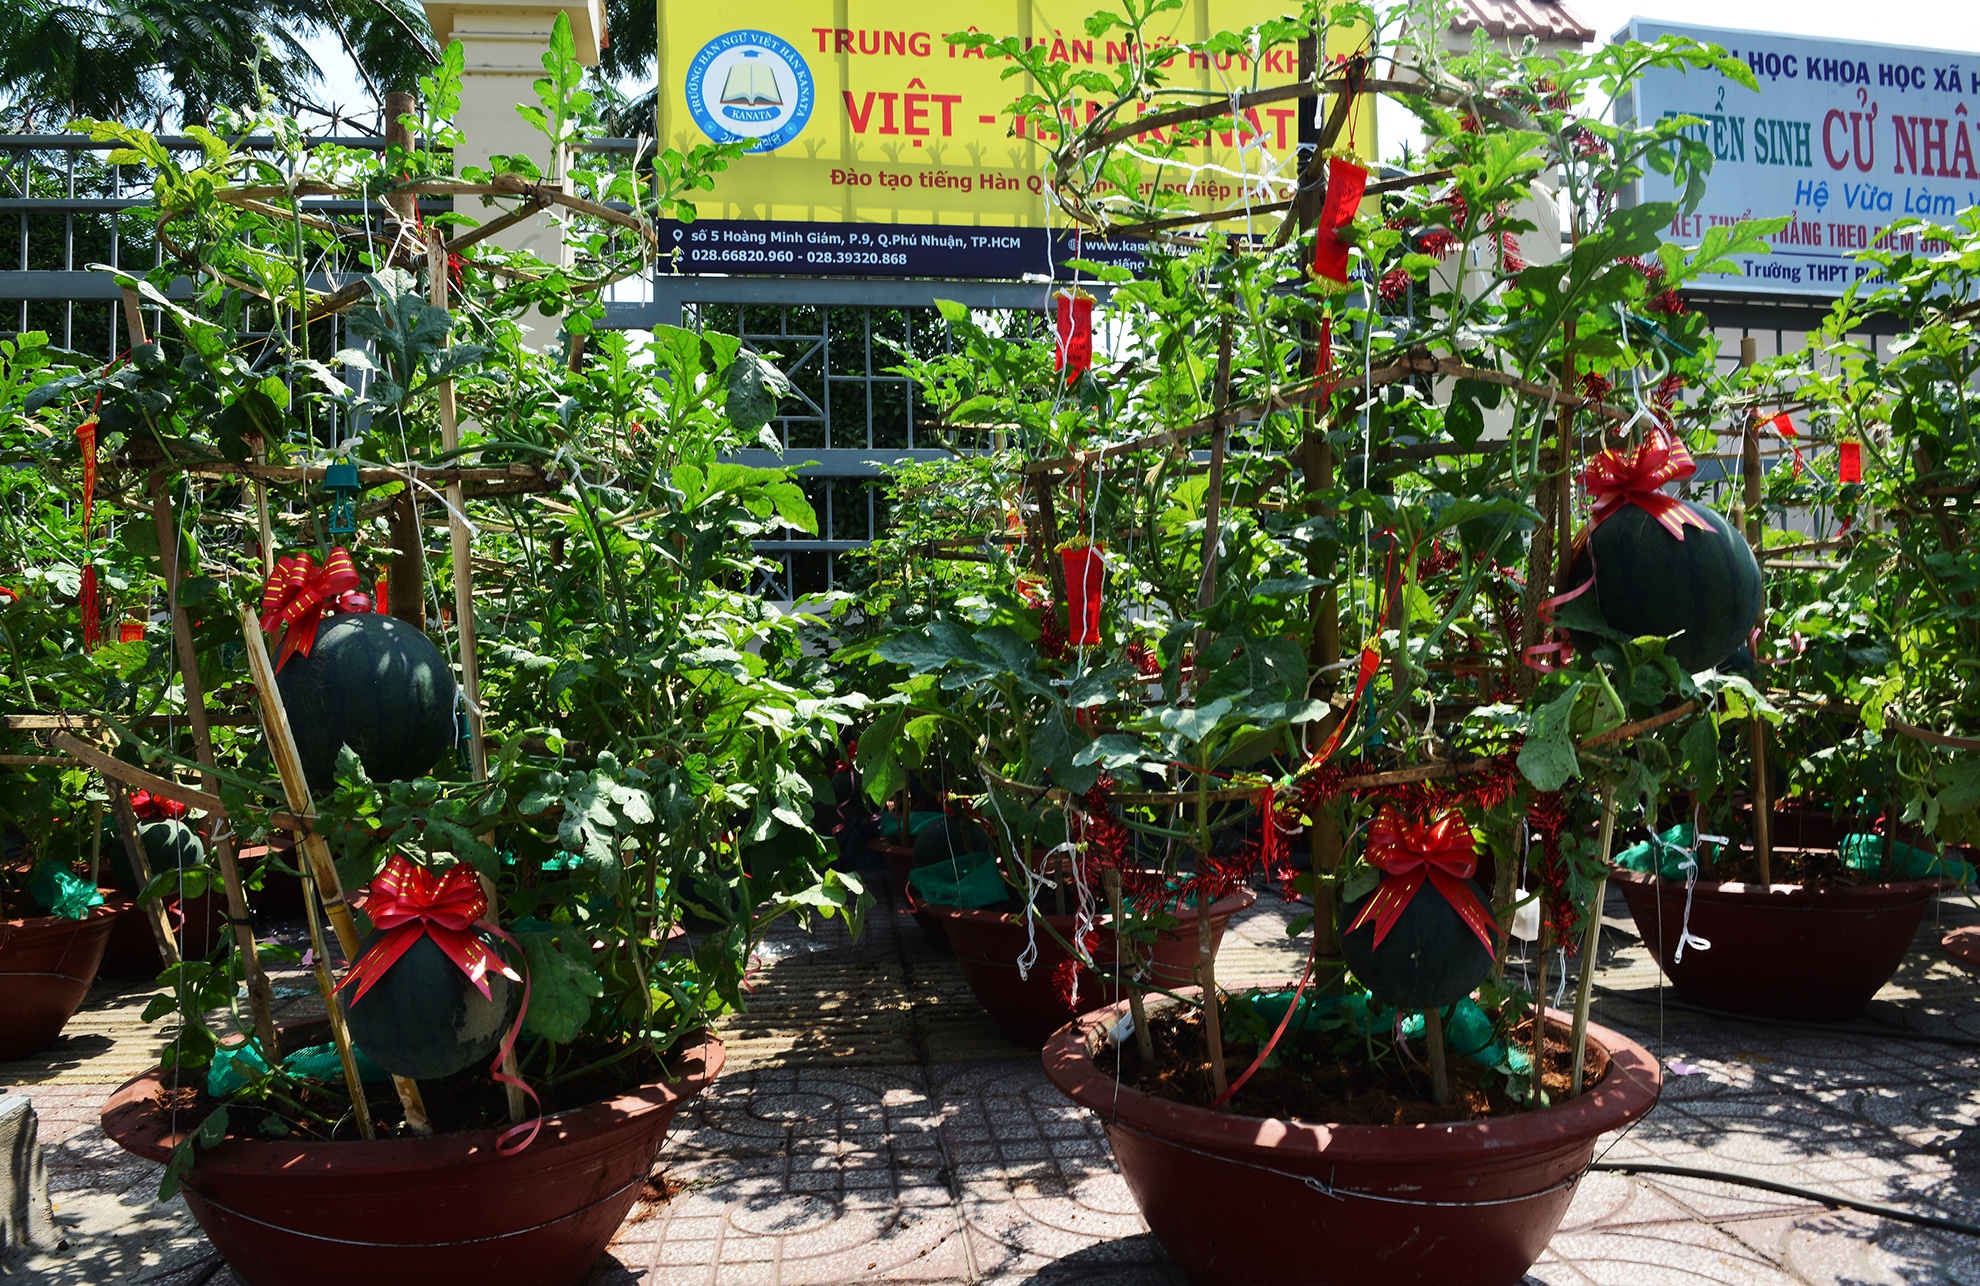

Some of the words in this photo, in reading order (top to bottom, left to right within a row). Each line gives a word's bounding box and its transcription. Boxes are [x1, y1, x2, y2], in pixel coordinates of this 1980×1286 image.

[812, 27, 931, 58] TRUNG
[942, 26, 1012, 60] TÂ
[1265, 49, 1348, 76] KH
[688, 66, 703, 116] TRƯỜNG
[698, 43, 721, 65] HÀN
[721, 32, 748, 48] NGỮ
[751, 34, 780, 50] VIỆT
[780, 46, 802, 69] HÀN
[796, 70, 810, 118] KANATA
[1748, 51, 1798, 81] HỌC
[1806, 56, 1871, 86] KHOA
[1878, 63, 1926, 93] HỌC
[1933, 64, 1963, 93] XÃ
[732, 109, 772, 121] KANATA
[841, 78, 963, 147] VIỆT
[979, 115, 996, 124] -
[1754, 117, 1813, 168] SINH
[1822, 87, 1878, 173] CỬ
[1891, 101, 1980, 181] NHÂ
[830, 167, 872, 186] Đào
[878, 170, 913, 191] tạo
[919, 170, 972, 193] tiếng
[980, 172, 1020, 190] Hàn
[1027, 175, 1080, 196] Qu
[1795, 179, 1829, 214] Hệ
[1843, 182, 1893, 213] Vừa
[1904, 186, 1956, 216] Làm
[691, 229, 707, 242] số
[711, 230, 719, 241] 5
[723, 230, 766, 245] Hoàng
[770, 231, 803, 243] Minh
[806, 231, 845, 246] Giám,
[849, 233, 874, 247] P.9,
[877, 233, 917, 248] Q.Phú
[921, 234, 967, 249] Nhuận,
[971, 236, 1021, 249] TP.HCM
[1827, 223, 1867, 249] THEO
[691, 249, 794, 263] 028.66820.960
[806, 251, 907, 265] 028.39320.868
[1743, 259, 1802, 283] Trường
[1806, 263, 1849, 282] THPT
